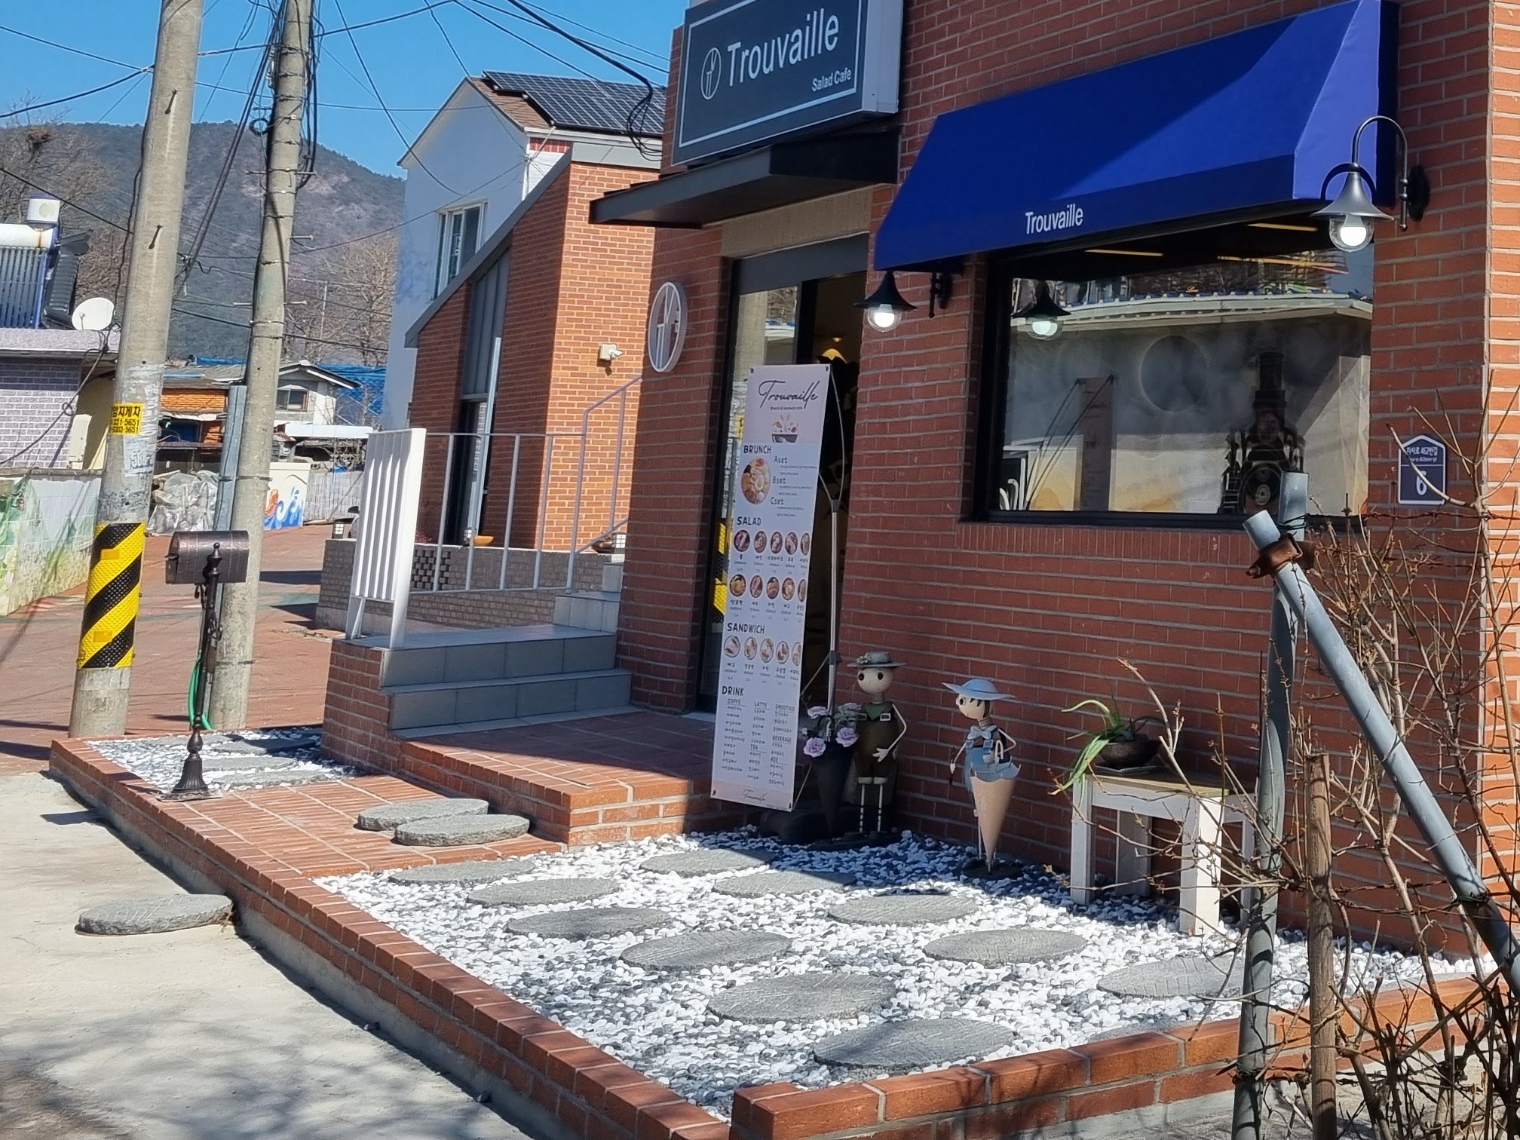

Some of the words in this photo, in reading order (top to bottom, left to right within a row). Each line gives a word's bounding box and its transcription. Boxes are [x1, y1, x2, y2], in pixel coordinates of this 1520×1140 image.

[727, 7, 840, 87] Trouvaille
[811, 72, 833, 92] Salad
[834, 66, 852, 85] Cafe
[1024, 202, 1084, 235] Trouvaille
[758, 379, 820, 409] Trouvaille
[743, 444, 772, 454] BRUNCH
[1416, 470, 1427, 496] 6
[736, 516, 761, 526] SALAD
[727, 622, 765, 635] SANDWICH
[722, 685, 744, 696] DRINK
